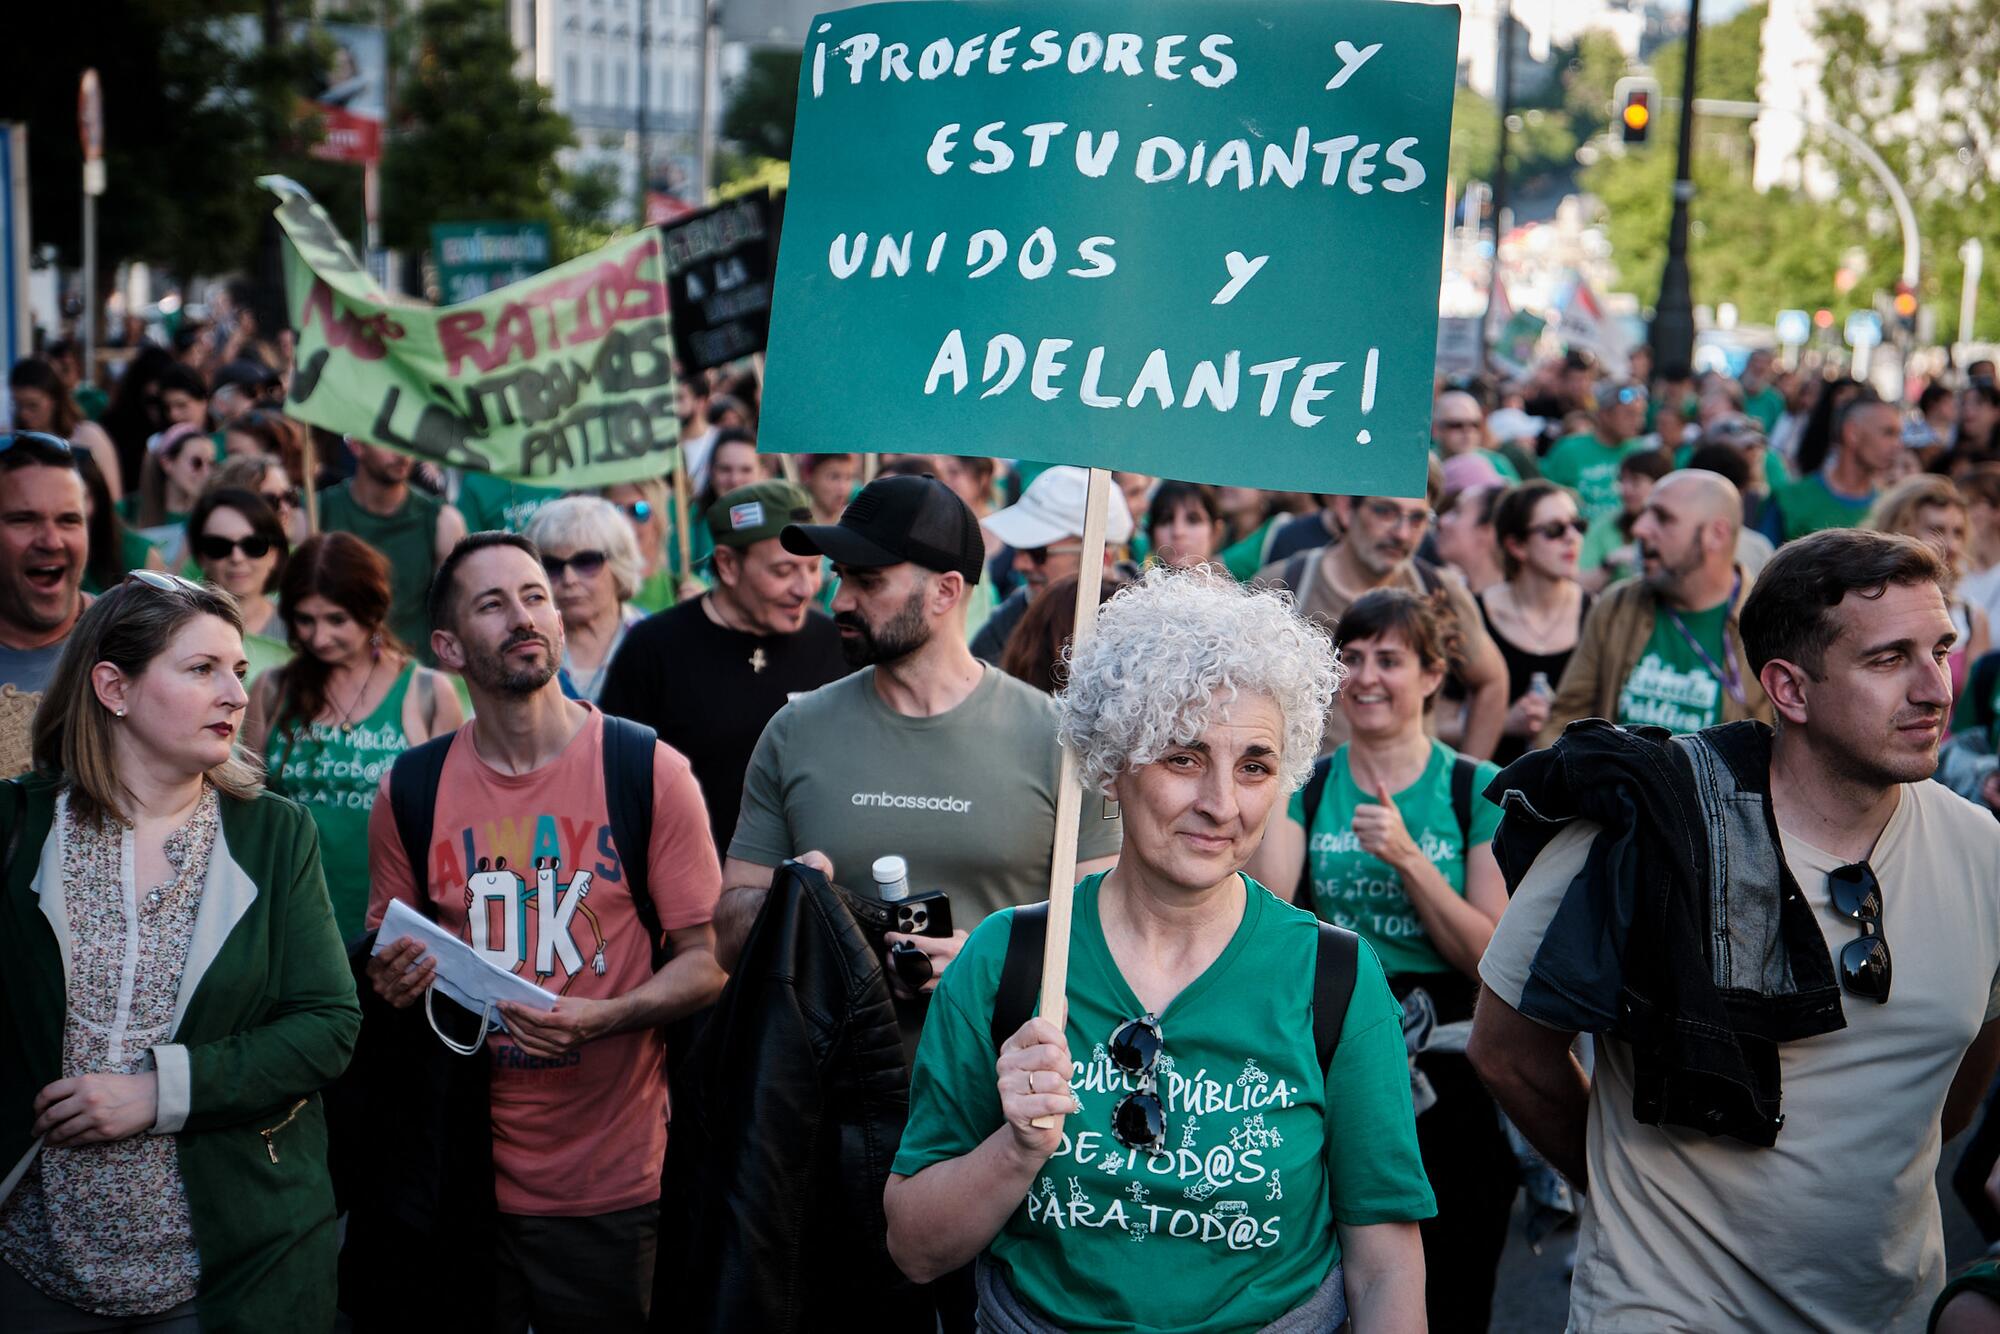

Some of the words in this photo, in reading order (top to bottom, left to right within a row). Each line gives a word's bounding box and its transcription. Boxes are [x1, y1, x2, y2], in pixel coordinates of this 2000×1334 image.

[812, 22, 1238, 99] ¡PROFESORES
[1326, 40, 1383, 90] Y
[926, 121, 1428, 195] ESTUDIANTES
[828, 226, 1117, 280] UNIDOS
[1211, 250, 1270, 305] Y
[437, 238, 668, 377] RATIOS
[924, 329, 1381, 446] ADELANTE!
[521, 394, 679, 476] PATIOS
[320, 759, 384, 784] TOD@
[851, 791, 972, 813] ambassador
[434, 815, 622, 898] ALWAYS
[467, 869, 593, 977] OK
[1167, 1068, 1299, 1115] PÚBLICA:
[1027, 1188, 1130, 1231] PARA
[1142, 1203, 1281, 1251] TOD@S
